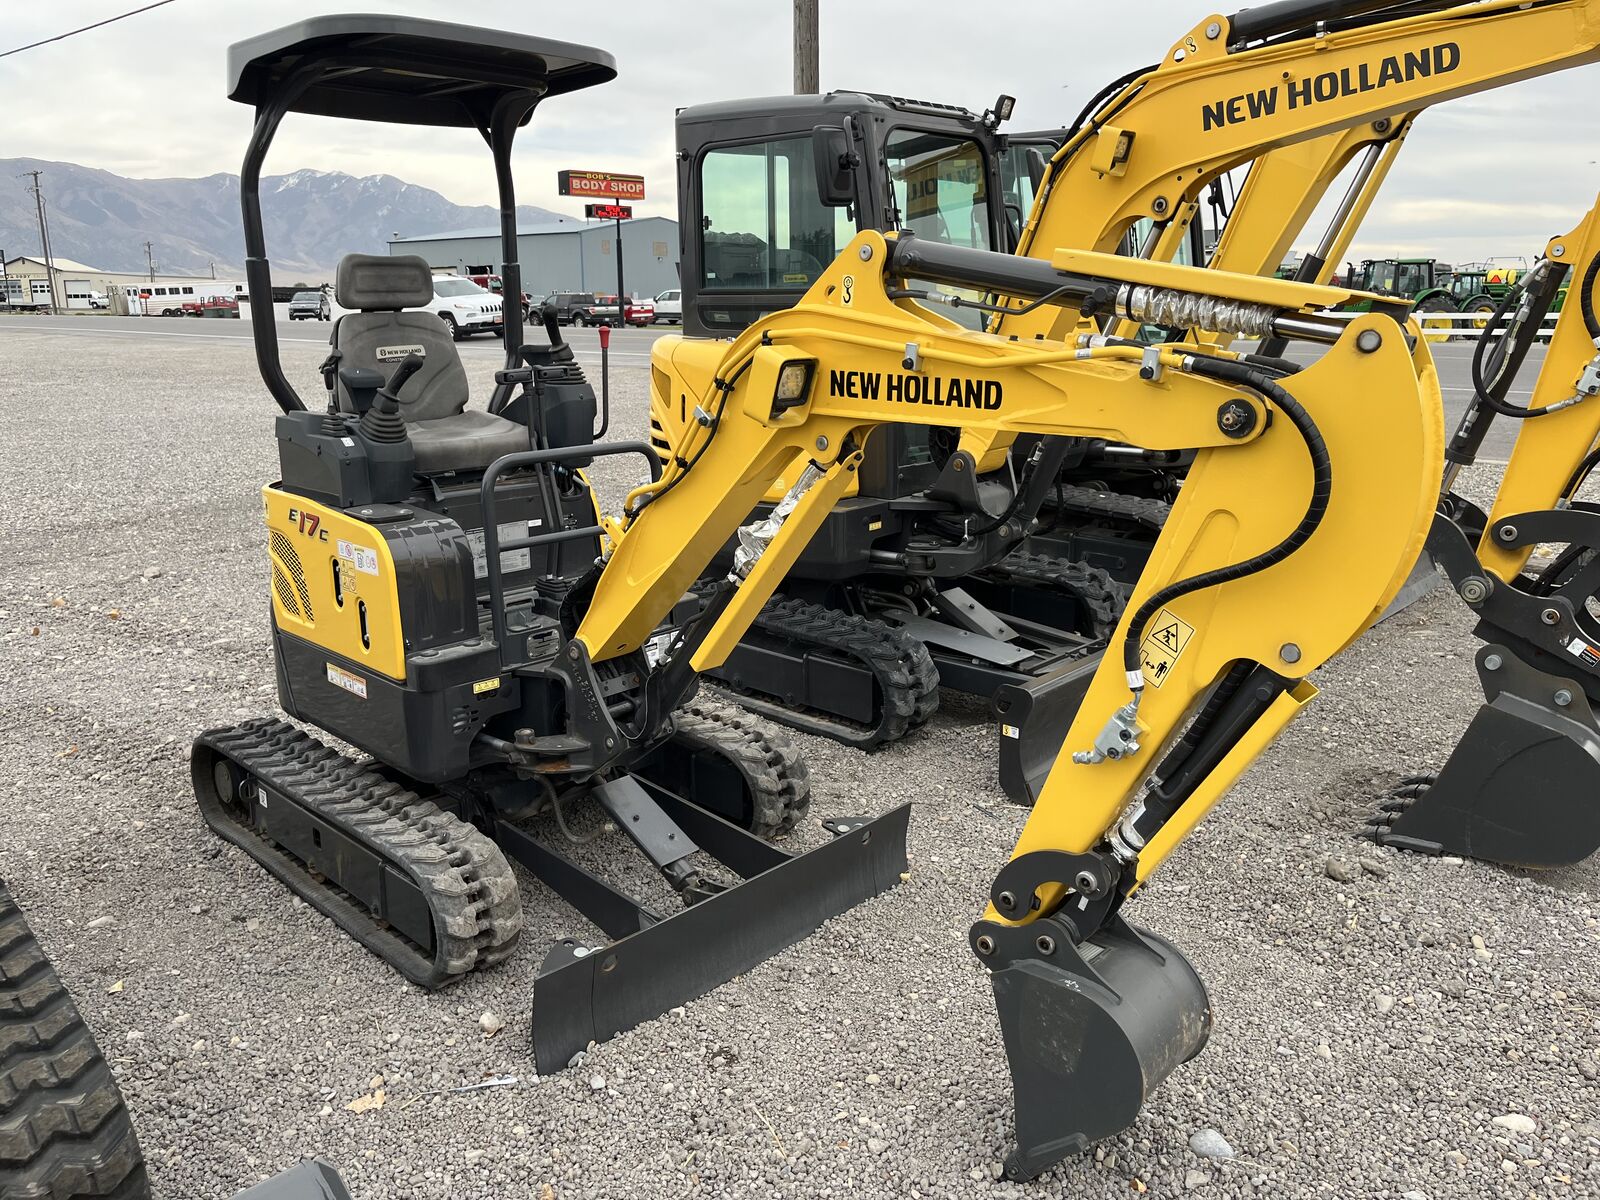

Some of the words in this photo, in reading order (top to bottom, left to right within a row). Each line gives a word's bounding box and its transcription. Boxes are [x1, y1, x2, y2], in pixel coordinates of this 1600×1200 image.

[1202, 86, 1278, 132] NEW
[1287, 42, 1460, 110] HOLLAND
[572, 179, 606, 190] BODY
[610, 182, 643, 193] SHOP
[586, 173, 611, 181] BOB'S
[830, 369, 881, 400] NEW
[887, 374, 1002, 410] HOLLAND
